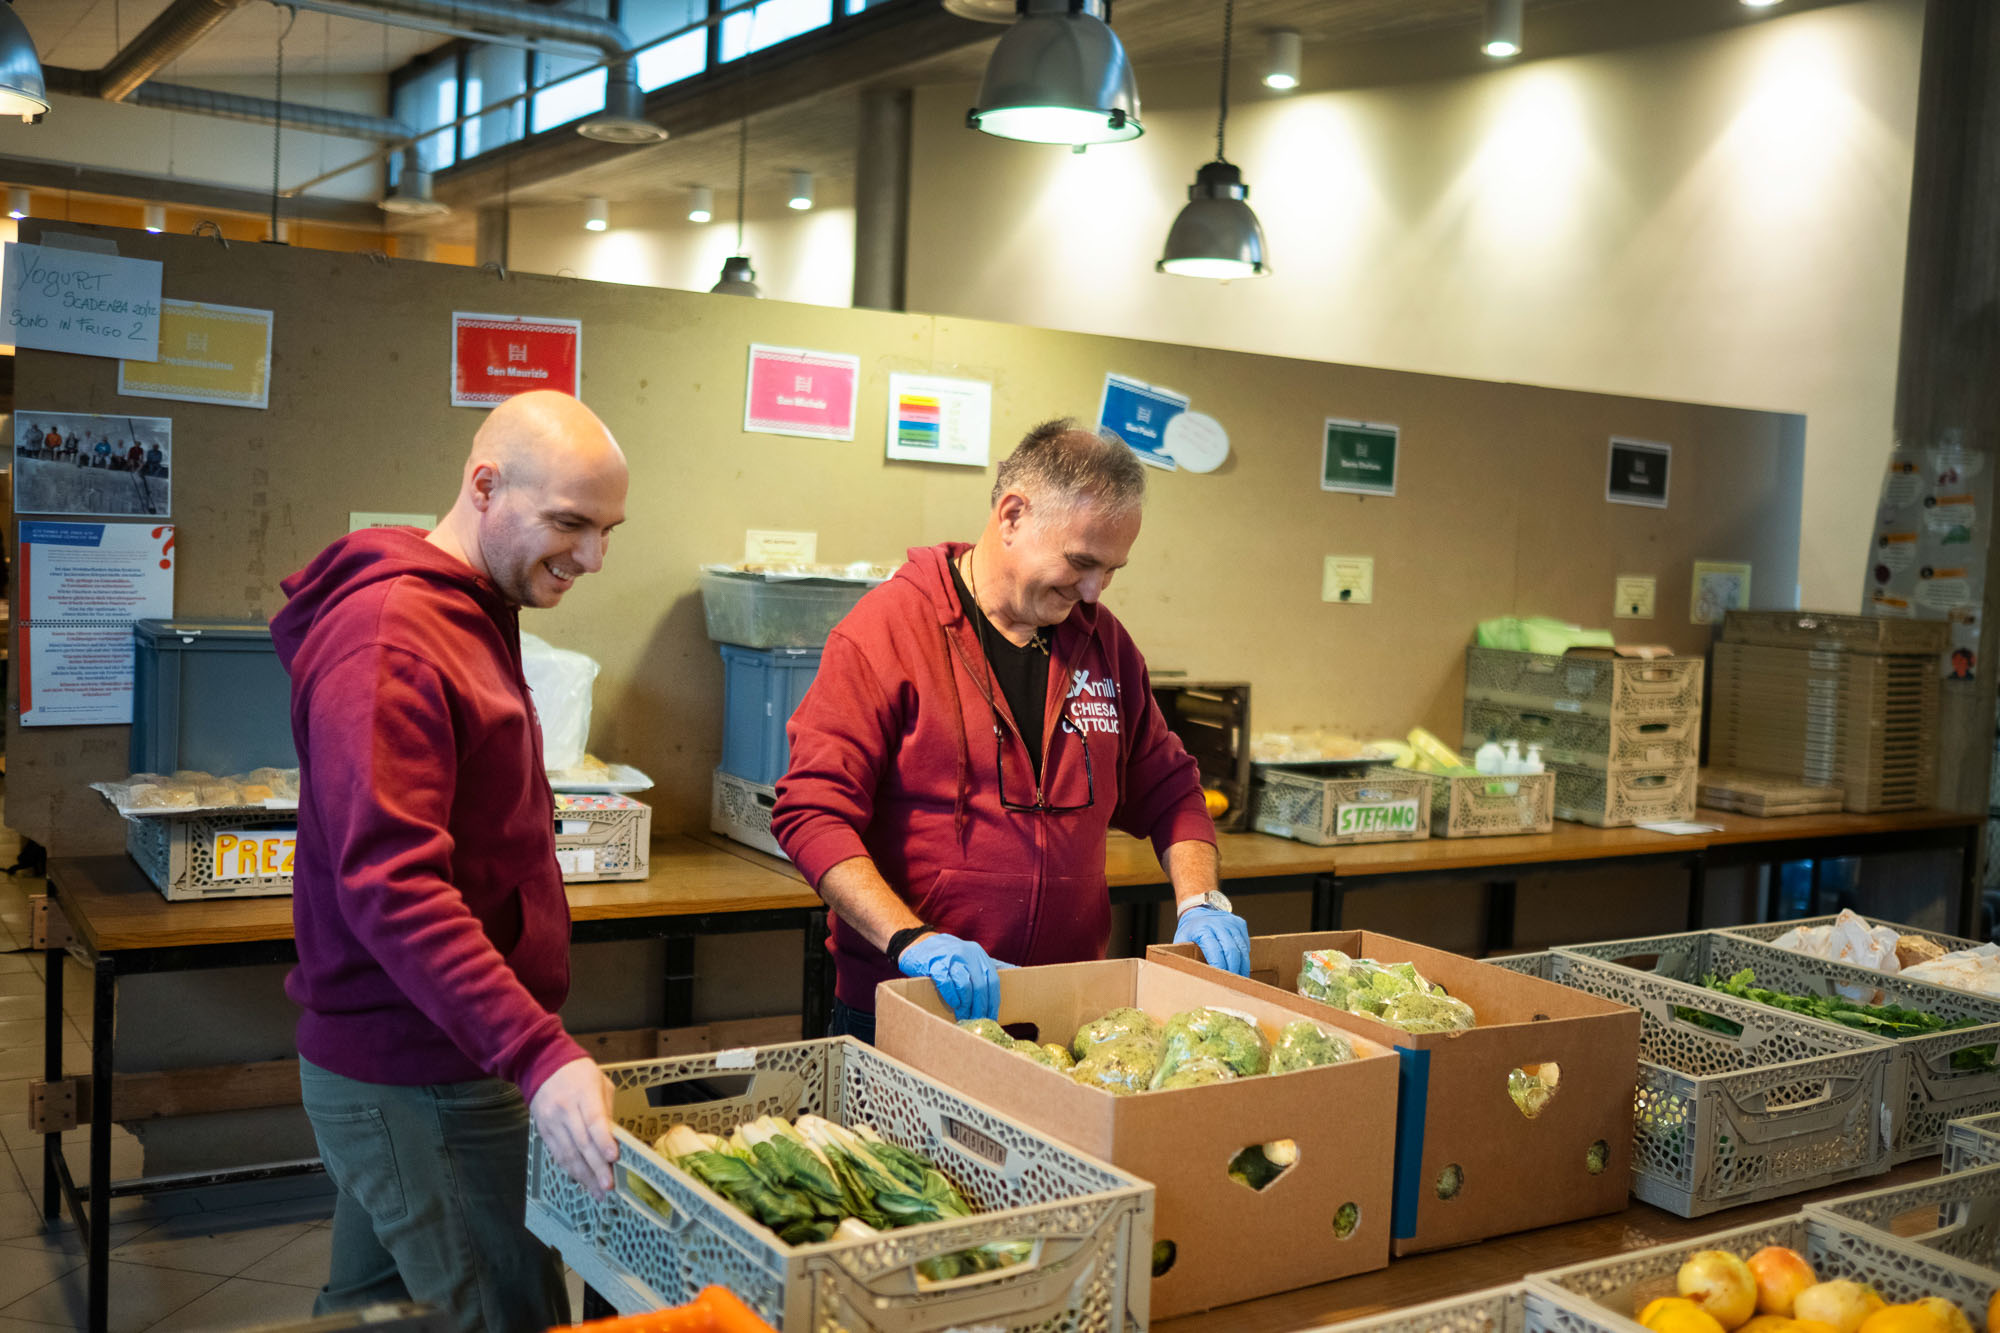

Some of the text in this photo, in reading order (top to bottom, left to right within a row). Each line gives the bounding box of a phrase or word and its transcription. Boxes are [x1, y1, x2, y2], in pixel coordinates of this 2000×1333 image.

[8, 309, 148, 342] SONO IN FRIGO 2
[487, 365, 548, 379] San Maurizio
[1070, 702, 1118, 718] CHIESA
[1341, 806, 1416, 831] STEFANO
